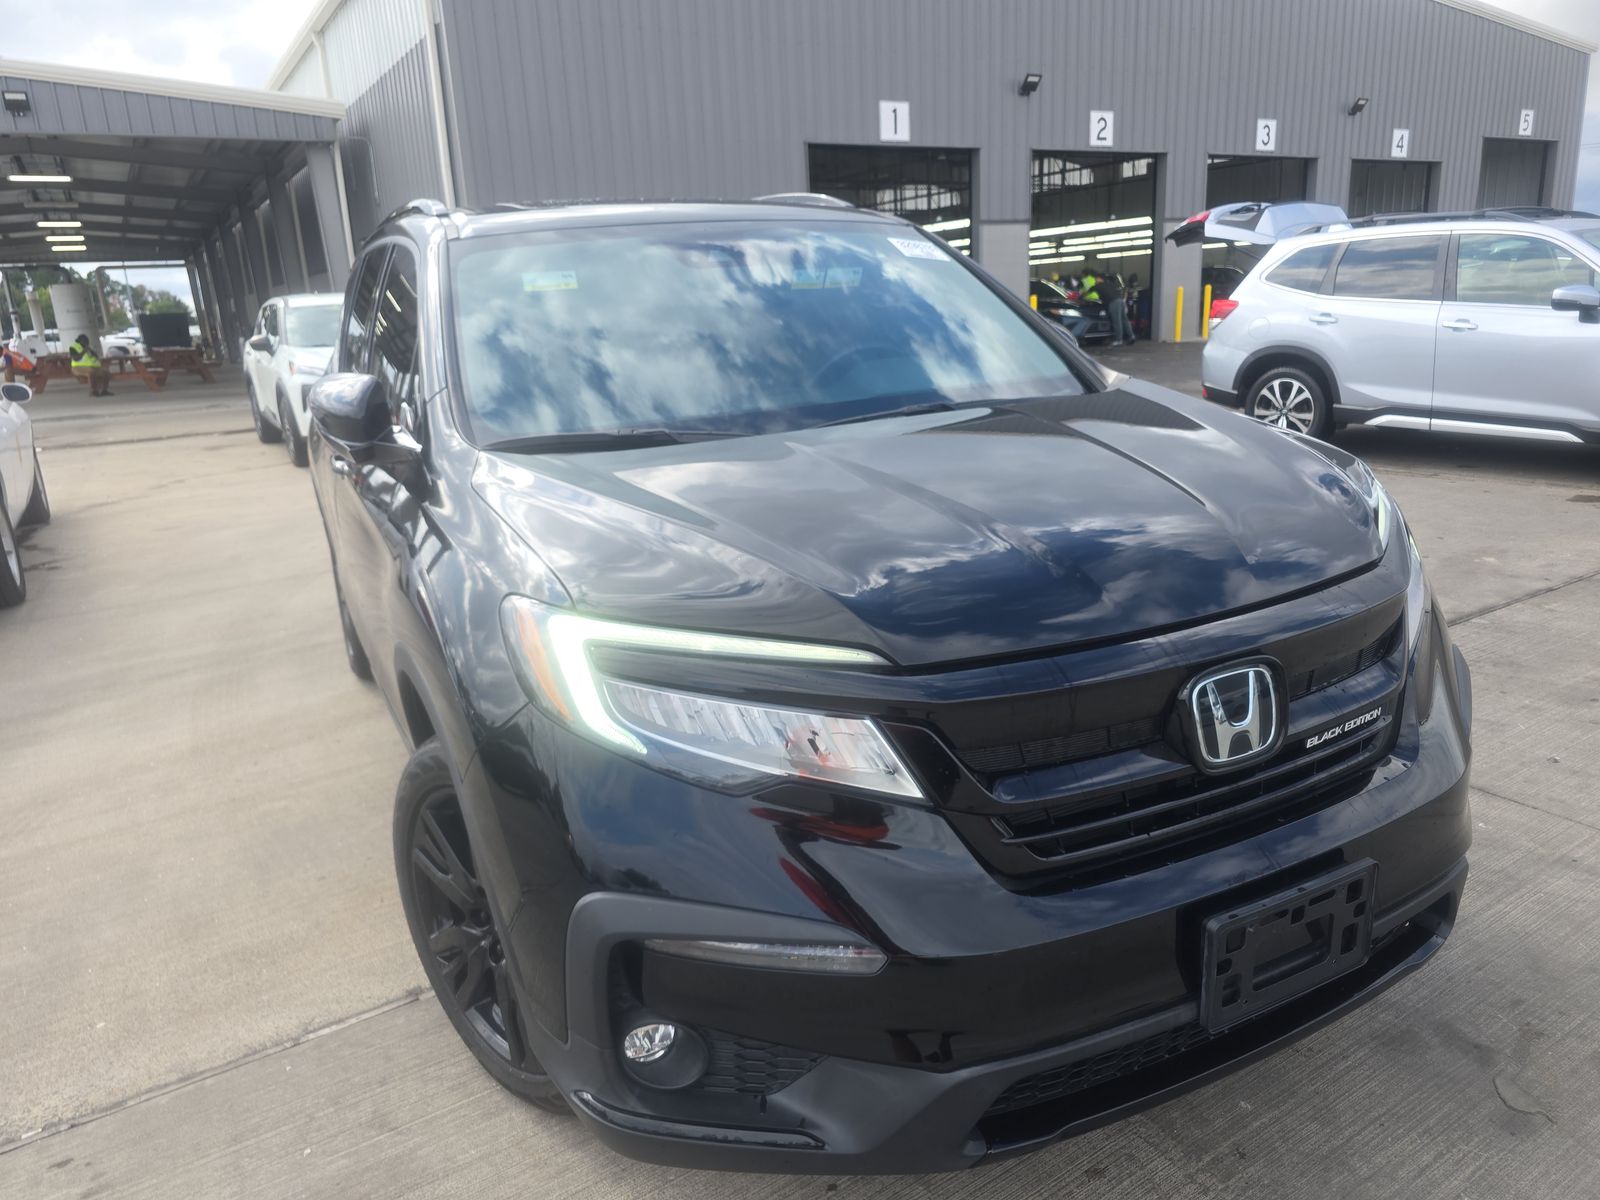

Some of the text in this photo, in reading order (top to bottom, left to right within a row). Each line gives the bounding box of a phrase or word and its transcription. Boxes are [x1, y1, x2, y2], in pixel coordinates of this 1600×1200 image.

[1097, 116, 1108, 141] 2
[1522, 113, 1530, 131] 5
[1261, 124, 1271, 145] 3
[1395, 133, 1405, 153] 4
[1306, 707, 1382, 749] BLACK EDITION
